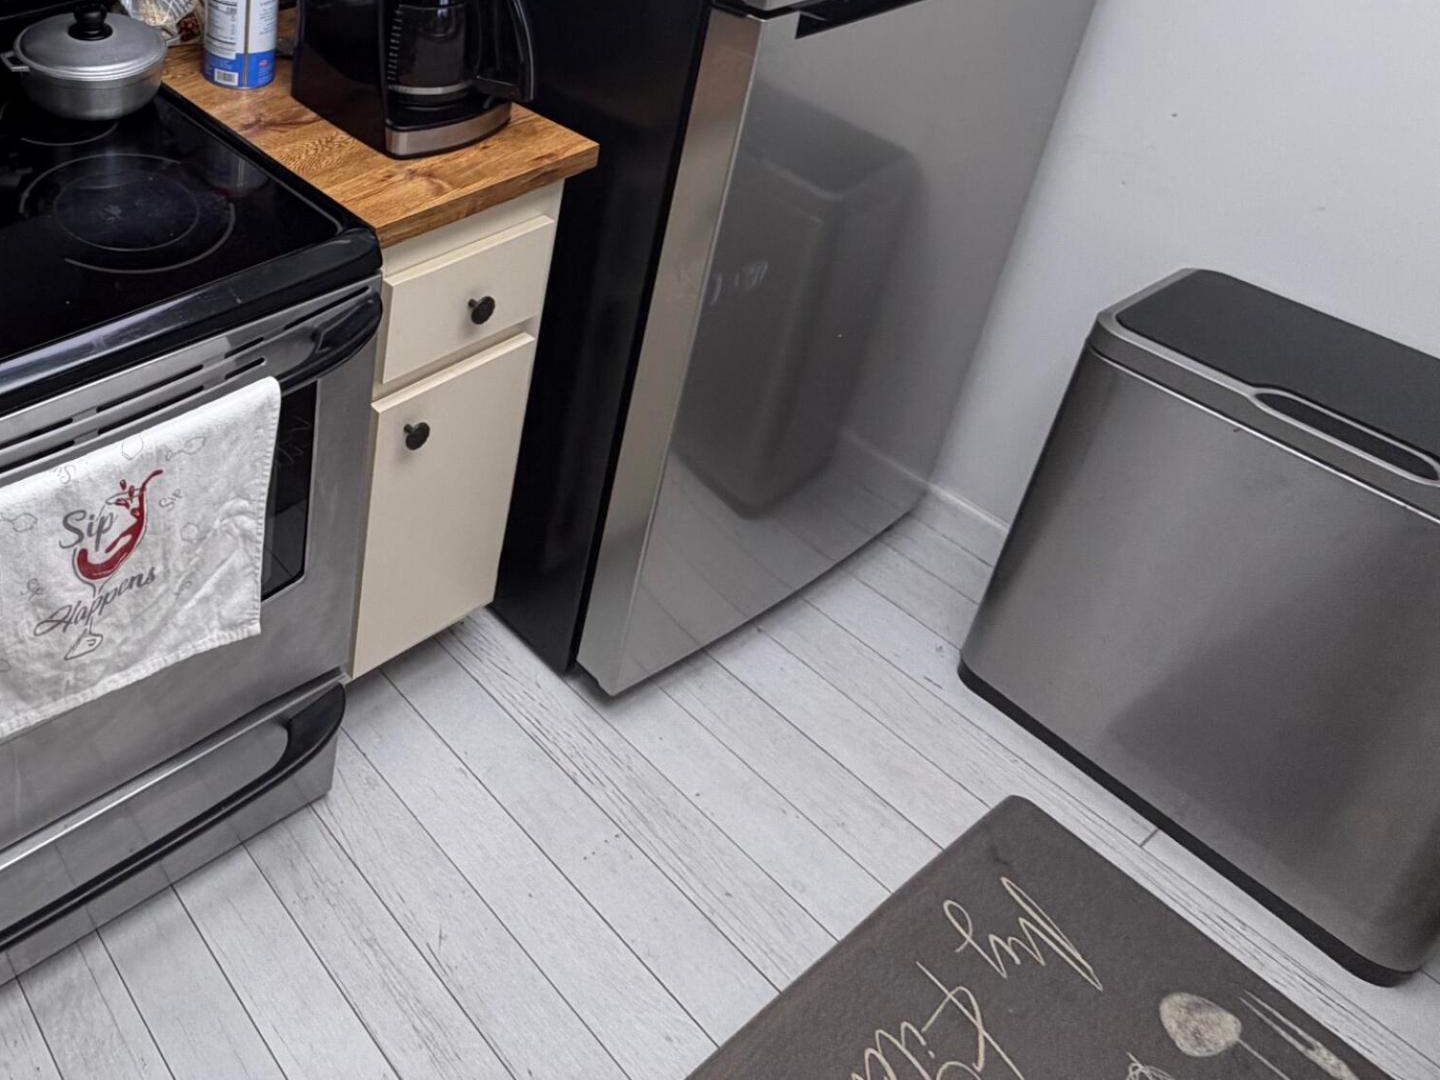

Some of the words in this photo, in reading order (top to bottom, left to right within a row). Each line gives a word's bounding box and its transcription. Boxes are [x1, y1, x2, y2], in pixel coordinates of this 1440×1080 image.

[60, 509, 117, 553] Sip
[34, 567, 157, 637] Happens
[943, 876, 1103, 992] My
